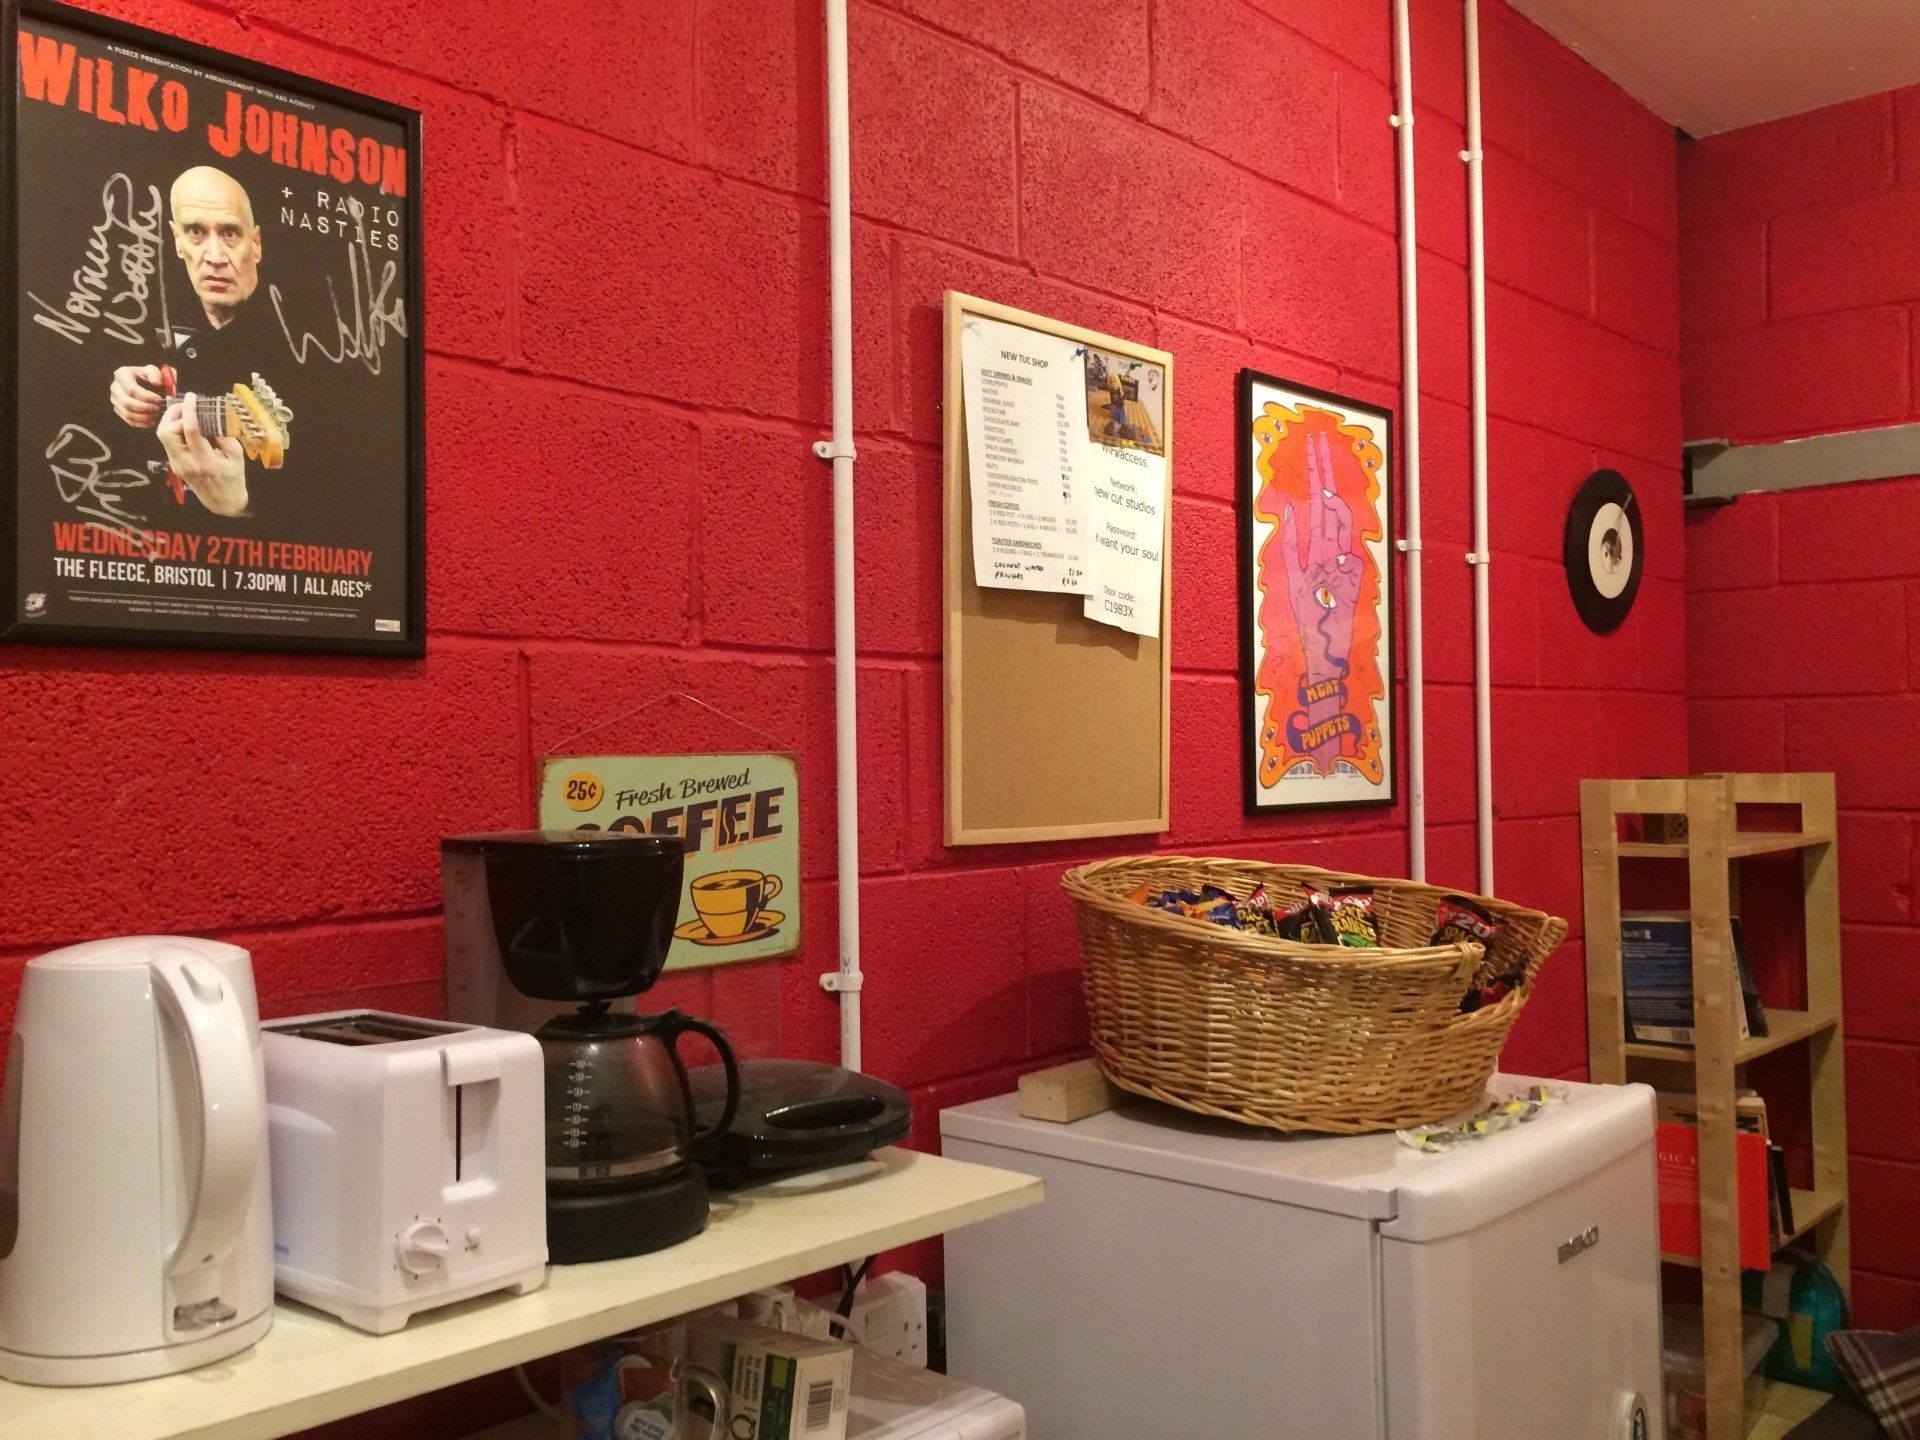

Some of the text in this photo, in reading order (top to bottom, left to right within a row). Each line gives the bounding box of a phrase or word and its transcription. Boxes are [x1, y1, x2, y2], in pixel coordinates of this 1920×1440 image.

[115, 46, 139, 59] FLEECE
[140, 53, 192, 74] PRESENTATION
[205, 73, 255, 93] ARRANGEMENT
[18, 30, 407, 198] WILKO JOHNSON
[317, 191, 399, 227] RADIO
[281, 206, 399, 252] NASTIES
[1001, 350, 1048, 369] NEW TUC SHOP
[1110, 476, 1138, 494] Network:
[1110, 492, 1123, 506] cut
[1125, 496, 1156, 516] studios
[53, 521, 373, 577] WEDNESDAY 27TH FEBRUARY
[1120, 543, 1139, 558] your
[1142, 548, 1159, 562] soul
[53, 557, 85, 578] THE
[89, 559, 150, 585] FLEECE,
[154, 564, 215, 588] BRISTOL
[234, 571, 287, 592] 7.30PM
[304, 576, 327, 596] ALL
[1104, 599, 1134, 618] C1983X
[1306, 680, 1340, 703] MEAT
[1301, 716, 1350, 751] PUPPETS
[566, 780, 597, 801] 25¢
[614, 768, 752, 811] Fresh Brewed
